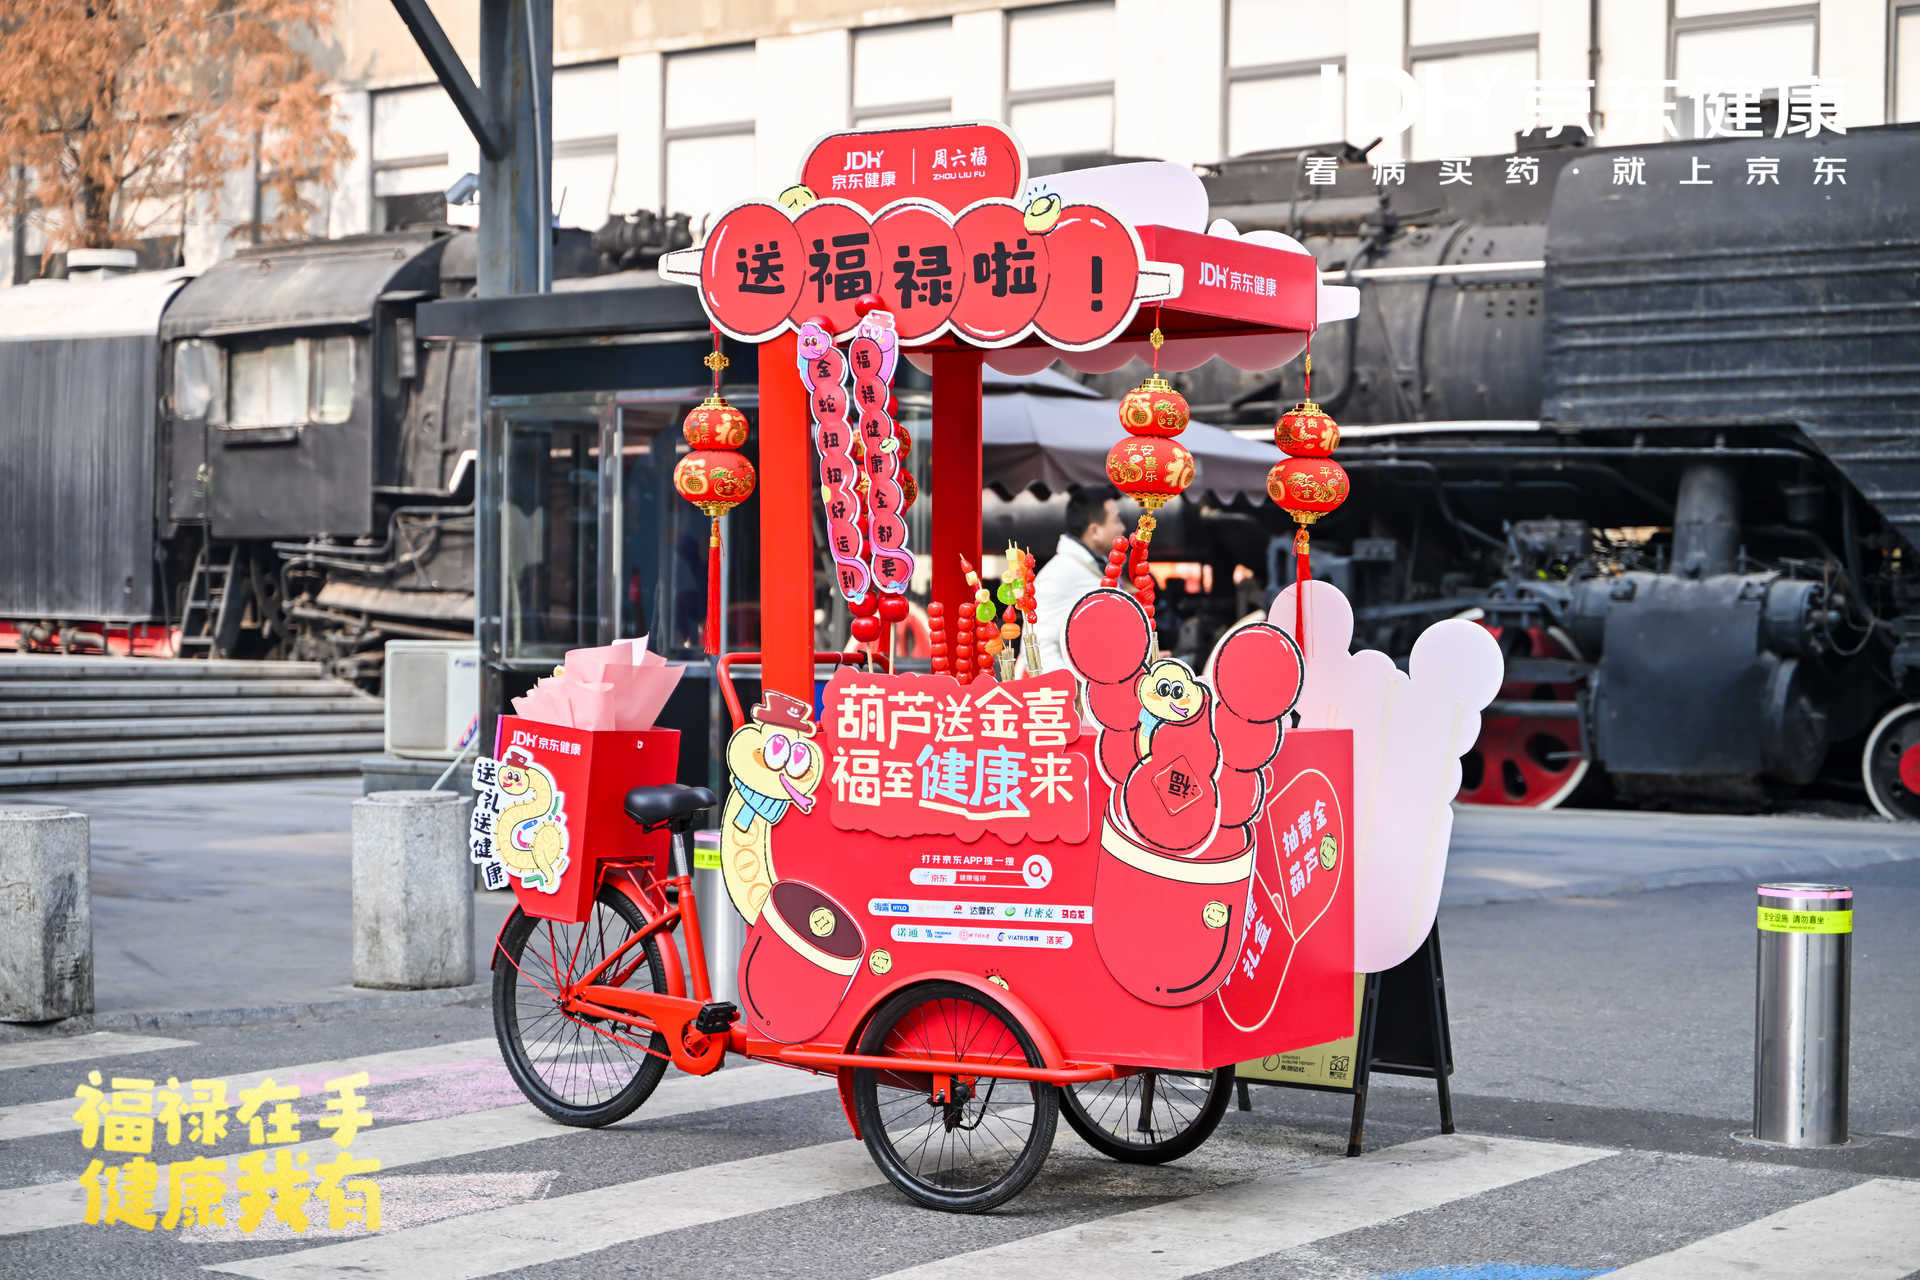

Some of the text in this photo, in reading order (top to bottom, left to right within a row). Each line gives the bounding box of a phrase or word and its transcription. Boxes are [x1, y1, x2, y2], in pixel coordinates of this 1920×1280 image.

[832, 171, 896, 190] 京东健康
[844, 150, 884, 171] JDH
[932, 146, 988, 169] 周六福
[933, 170, 985, 181] ZHOU LIU FU
[736, 232, 1104, 313] 送福禄啦！
[1198, 261, 1277, 297] JDH 京东健康
[816, 359, 856, 589] 金蛇扭扭好运到
[856, 350, 898, 578] 福禄健康全都要
[510, 730, 582, 756] JDH 京东健康
[837, 684, 1072, 750] 葫芦送金喜
[832, 743, 1074, 814] 福至健康来
[473, 762, 503, 887] 送礼送健康
[1282, 799, 1328, 859] 抽黄金
[921, 854, 1015, 867] 打开京东APP搜一搜
[1289, 846, 1319, 898] 葫芦
[1242, 915, 1272, 981] 礼盒
